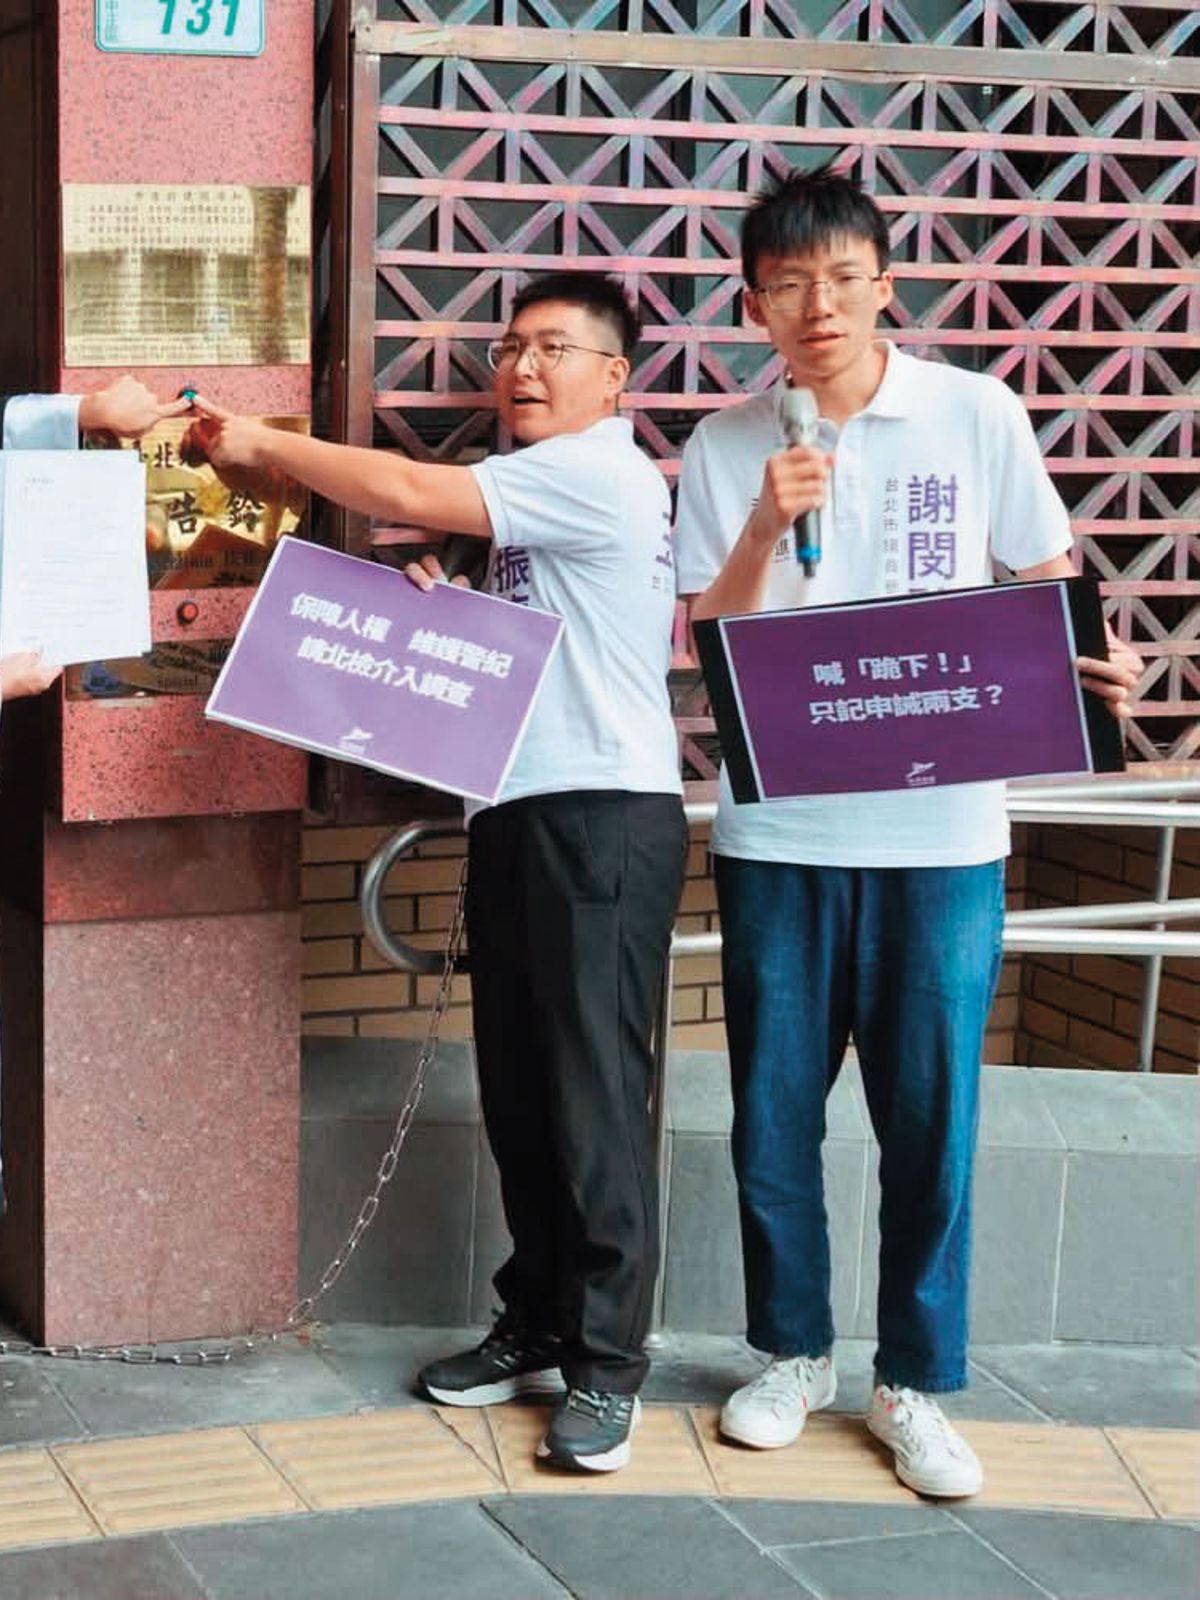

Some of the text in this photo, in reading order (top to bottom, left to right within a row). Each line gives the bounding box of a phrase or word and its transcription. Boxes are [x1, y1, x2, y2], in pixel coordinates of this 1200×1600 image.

[159, 0, 240, 36] 131
[907, 474, 959, 592] 謝閔
[290, 591, 514, 680] 保障人權 維護警紀
[296, 635, 476, 709] 請北檢介入調查
[809, 684, 1004, 725] 只記申誡兩支？
